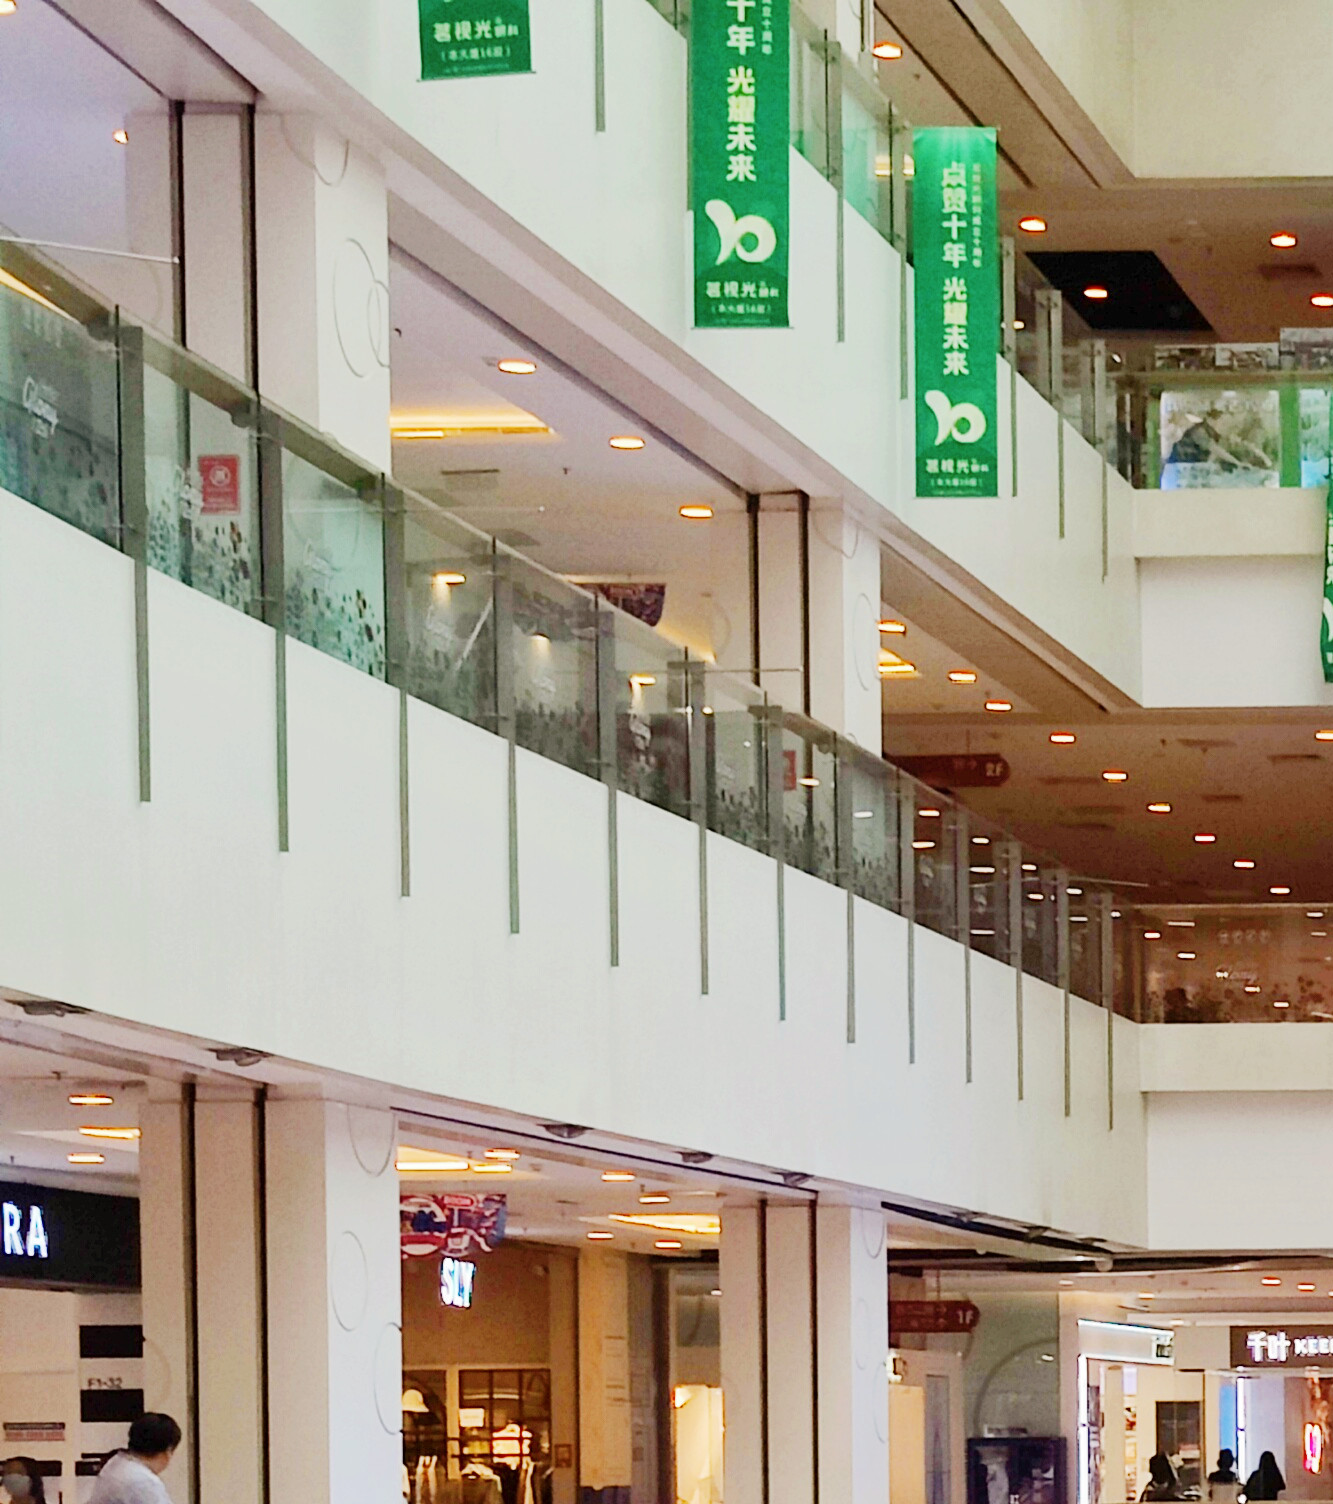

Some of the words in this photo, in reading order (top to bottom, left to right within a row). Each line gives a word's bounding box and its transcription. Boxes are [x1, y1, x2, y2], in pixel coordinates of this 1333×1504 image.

[942, 161, 967, 268] 点赞十年
[439, 1257, 476, 1309] SLY
[1247, 1331, 1291, 1362] 千叶
